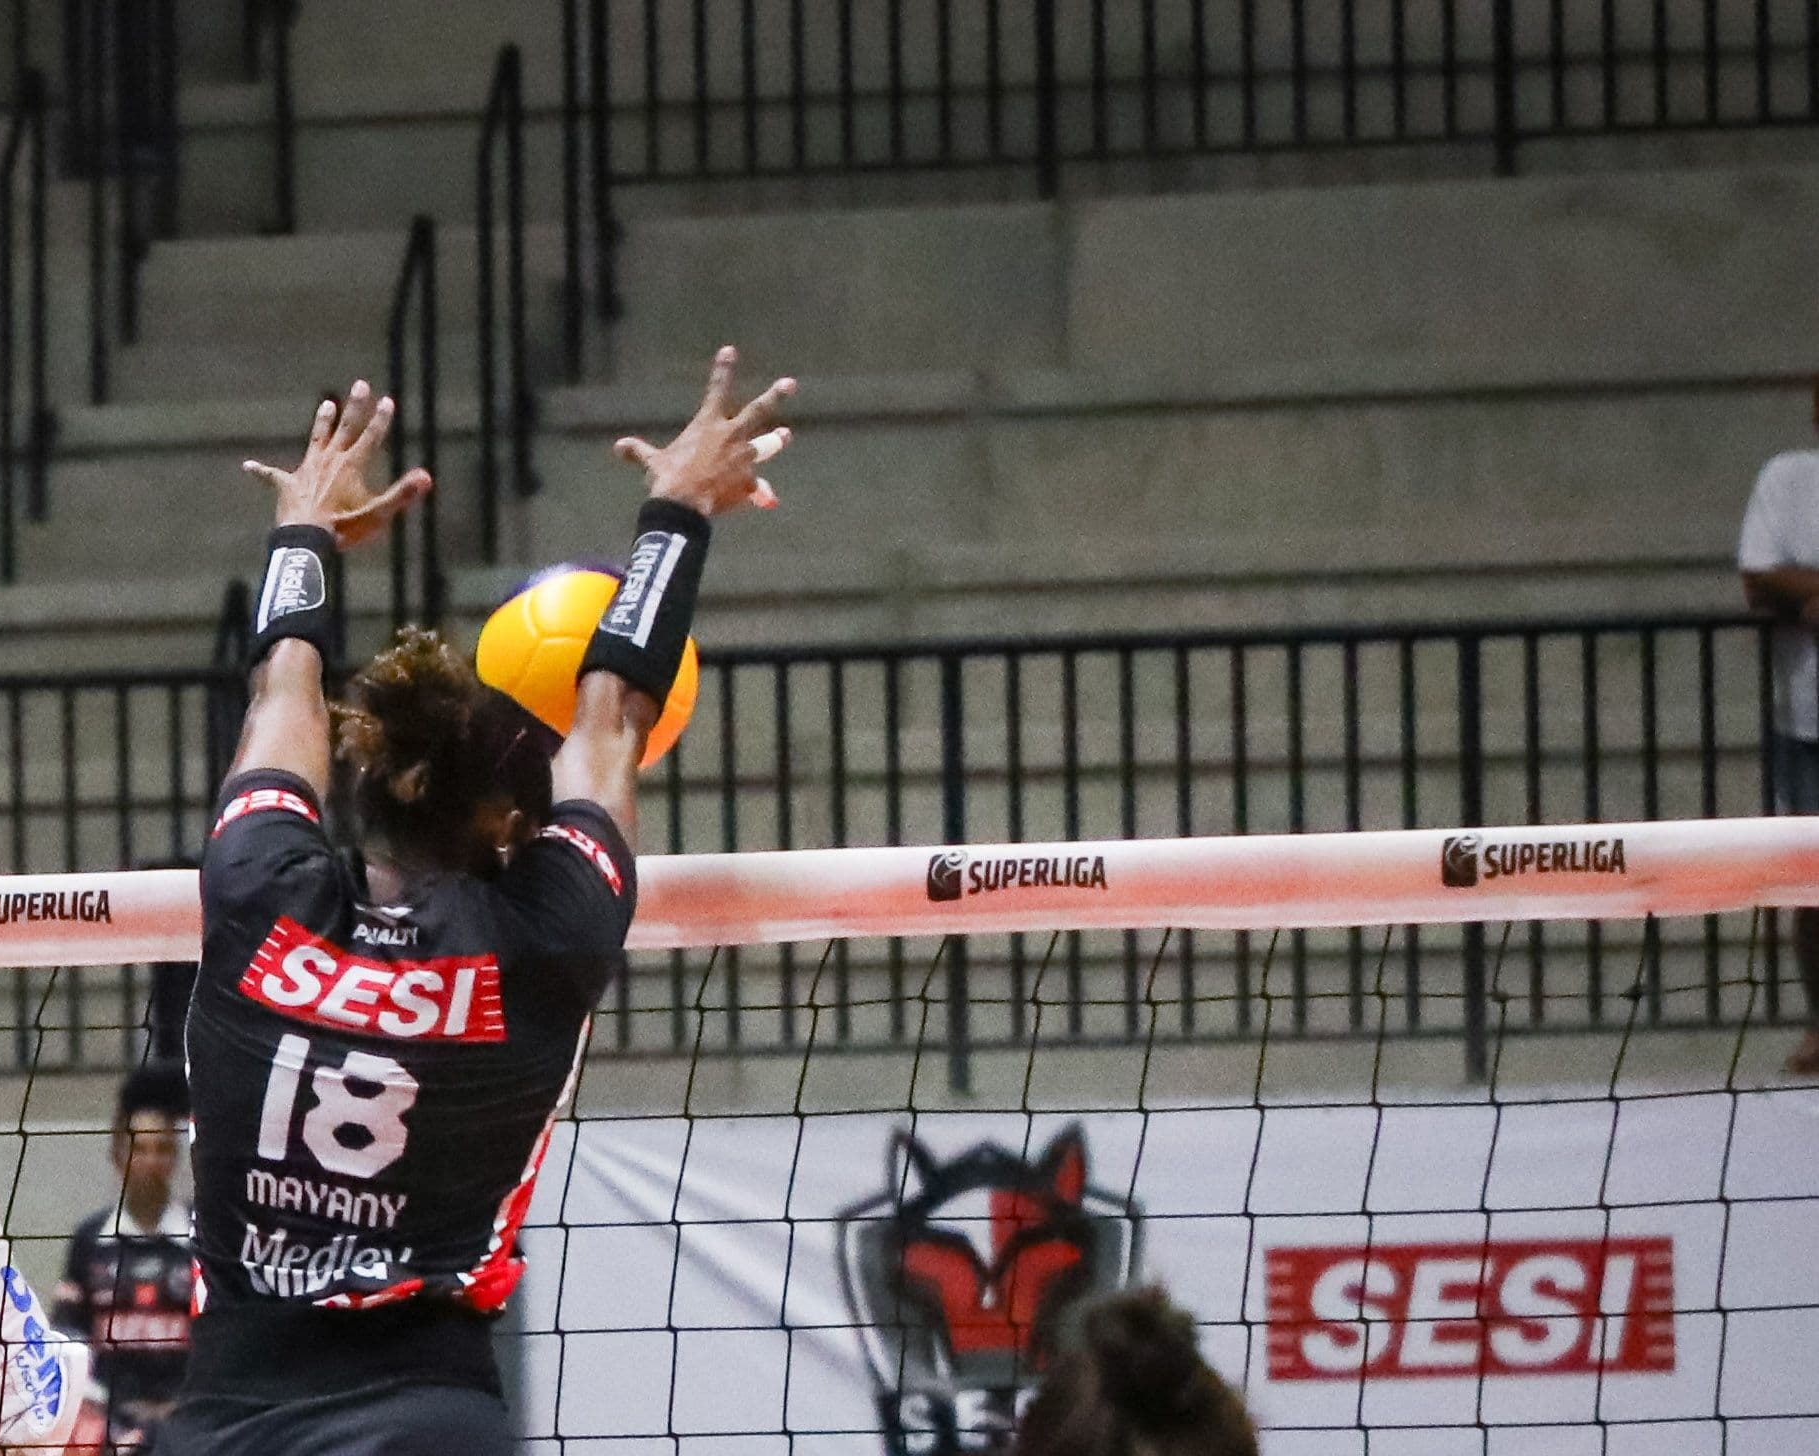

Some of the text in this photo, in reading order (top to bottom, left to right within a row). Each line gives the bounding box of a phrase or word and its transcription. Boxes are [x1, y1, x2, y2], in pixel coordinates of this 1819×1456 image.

[968, 855, 1108, 895] SUPERLIGA
[1483, 838, 1626, 879] SUPERLIGA
[261, 945, 476, 1037] SESI
[257, 1033, 420, 1179] 18
[246, 1168, 408, 1229] MAYANY
[1303, 1252, 1639, 1378] SESI
